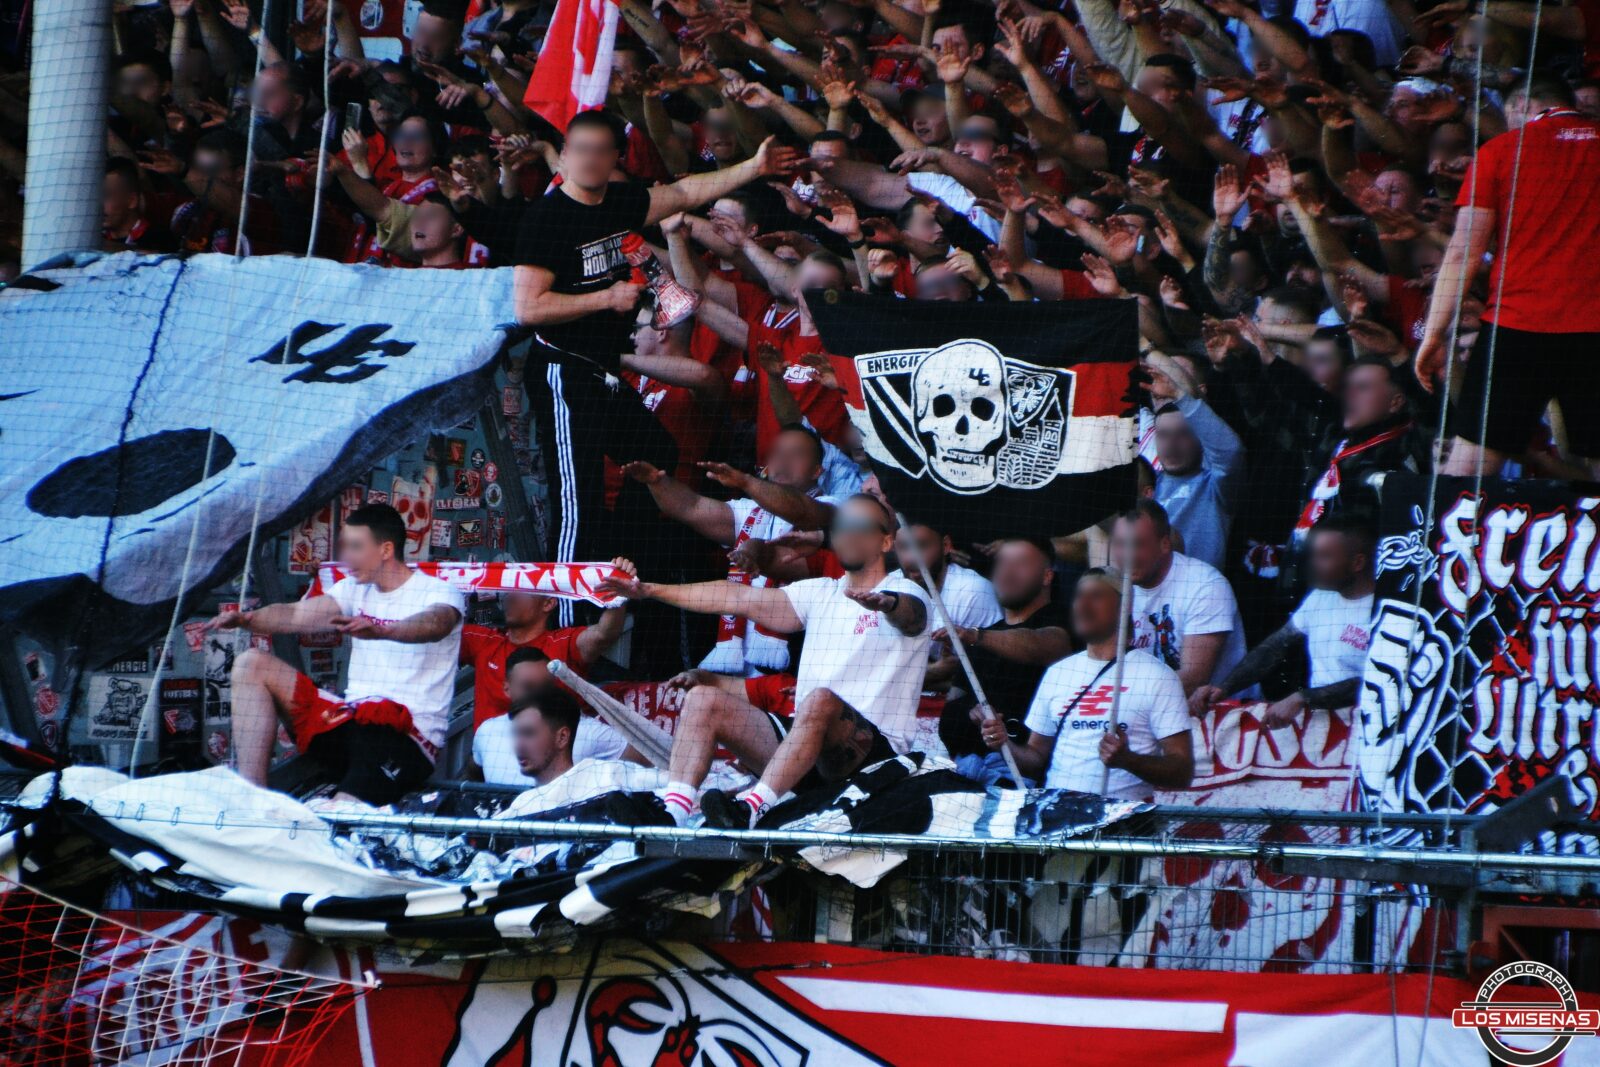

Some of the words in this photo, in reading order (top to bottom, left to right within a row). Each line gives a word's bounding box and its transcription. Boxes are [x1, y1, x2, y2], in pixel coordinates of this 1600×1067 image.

[1441, 496, 1600, 614] Frei
[107, 660, 147, 673] NERGIE
[1071, 718, 1128, 733] energe
